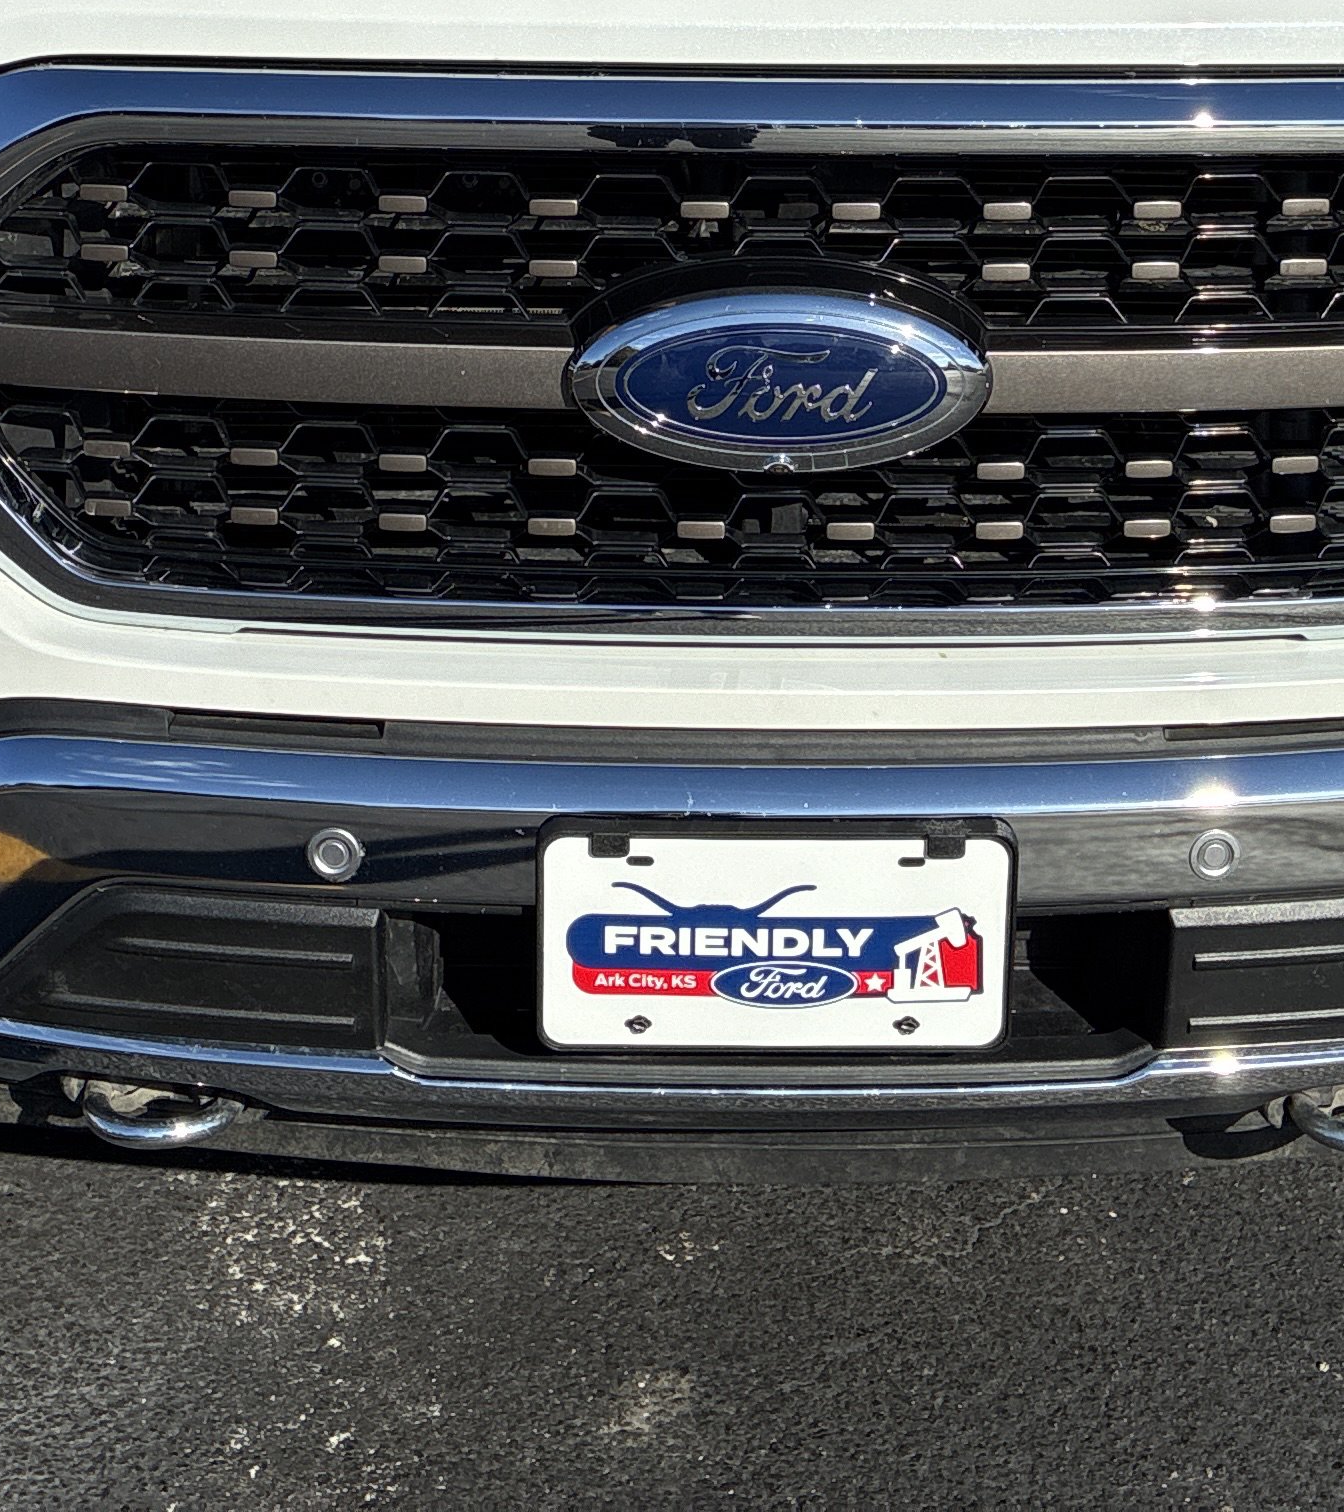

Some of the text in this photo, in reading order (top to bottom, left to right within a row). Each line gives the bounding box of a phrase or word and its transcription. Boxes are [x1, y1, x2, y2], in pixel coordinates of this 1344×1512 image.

[686, 344, 879, 423] Ford
[603, 925, 875, 958] FRIENDLY
[594, 972, 697, 990] Ark City, KS
[740, 966, 829, 999] Ford
